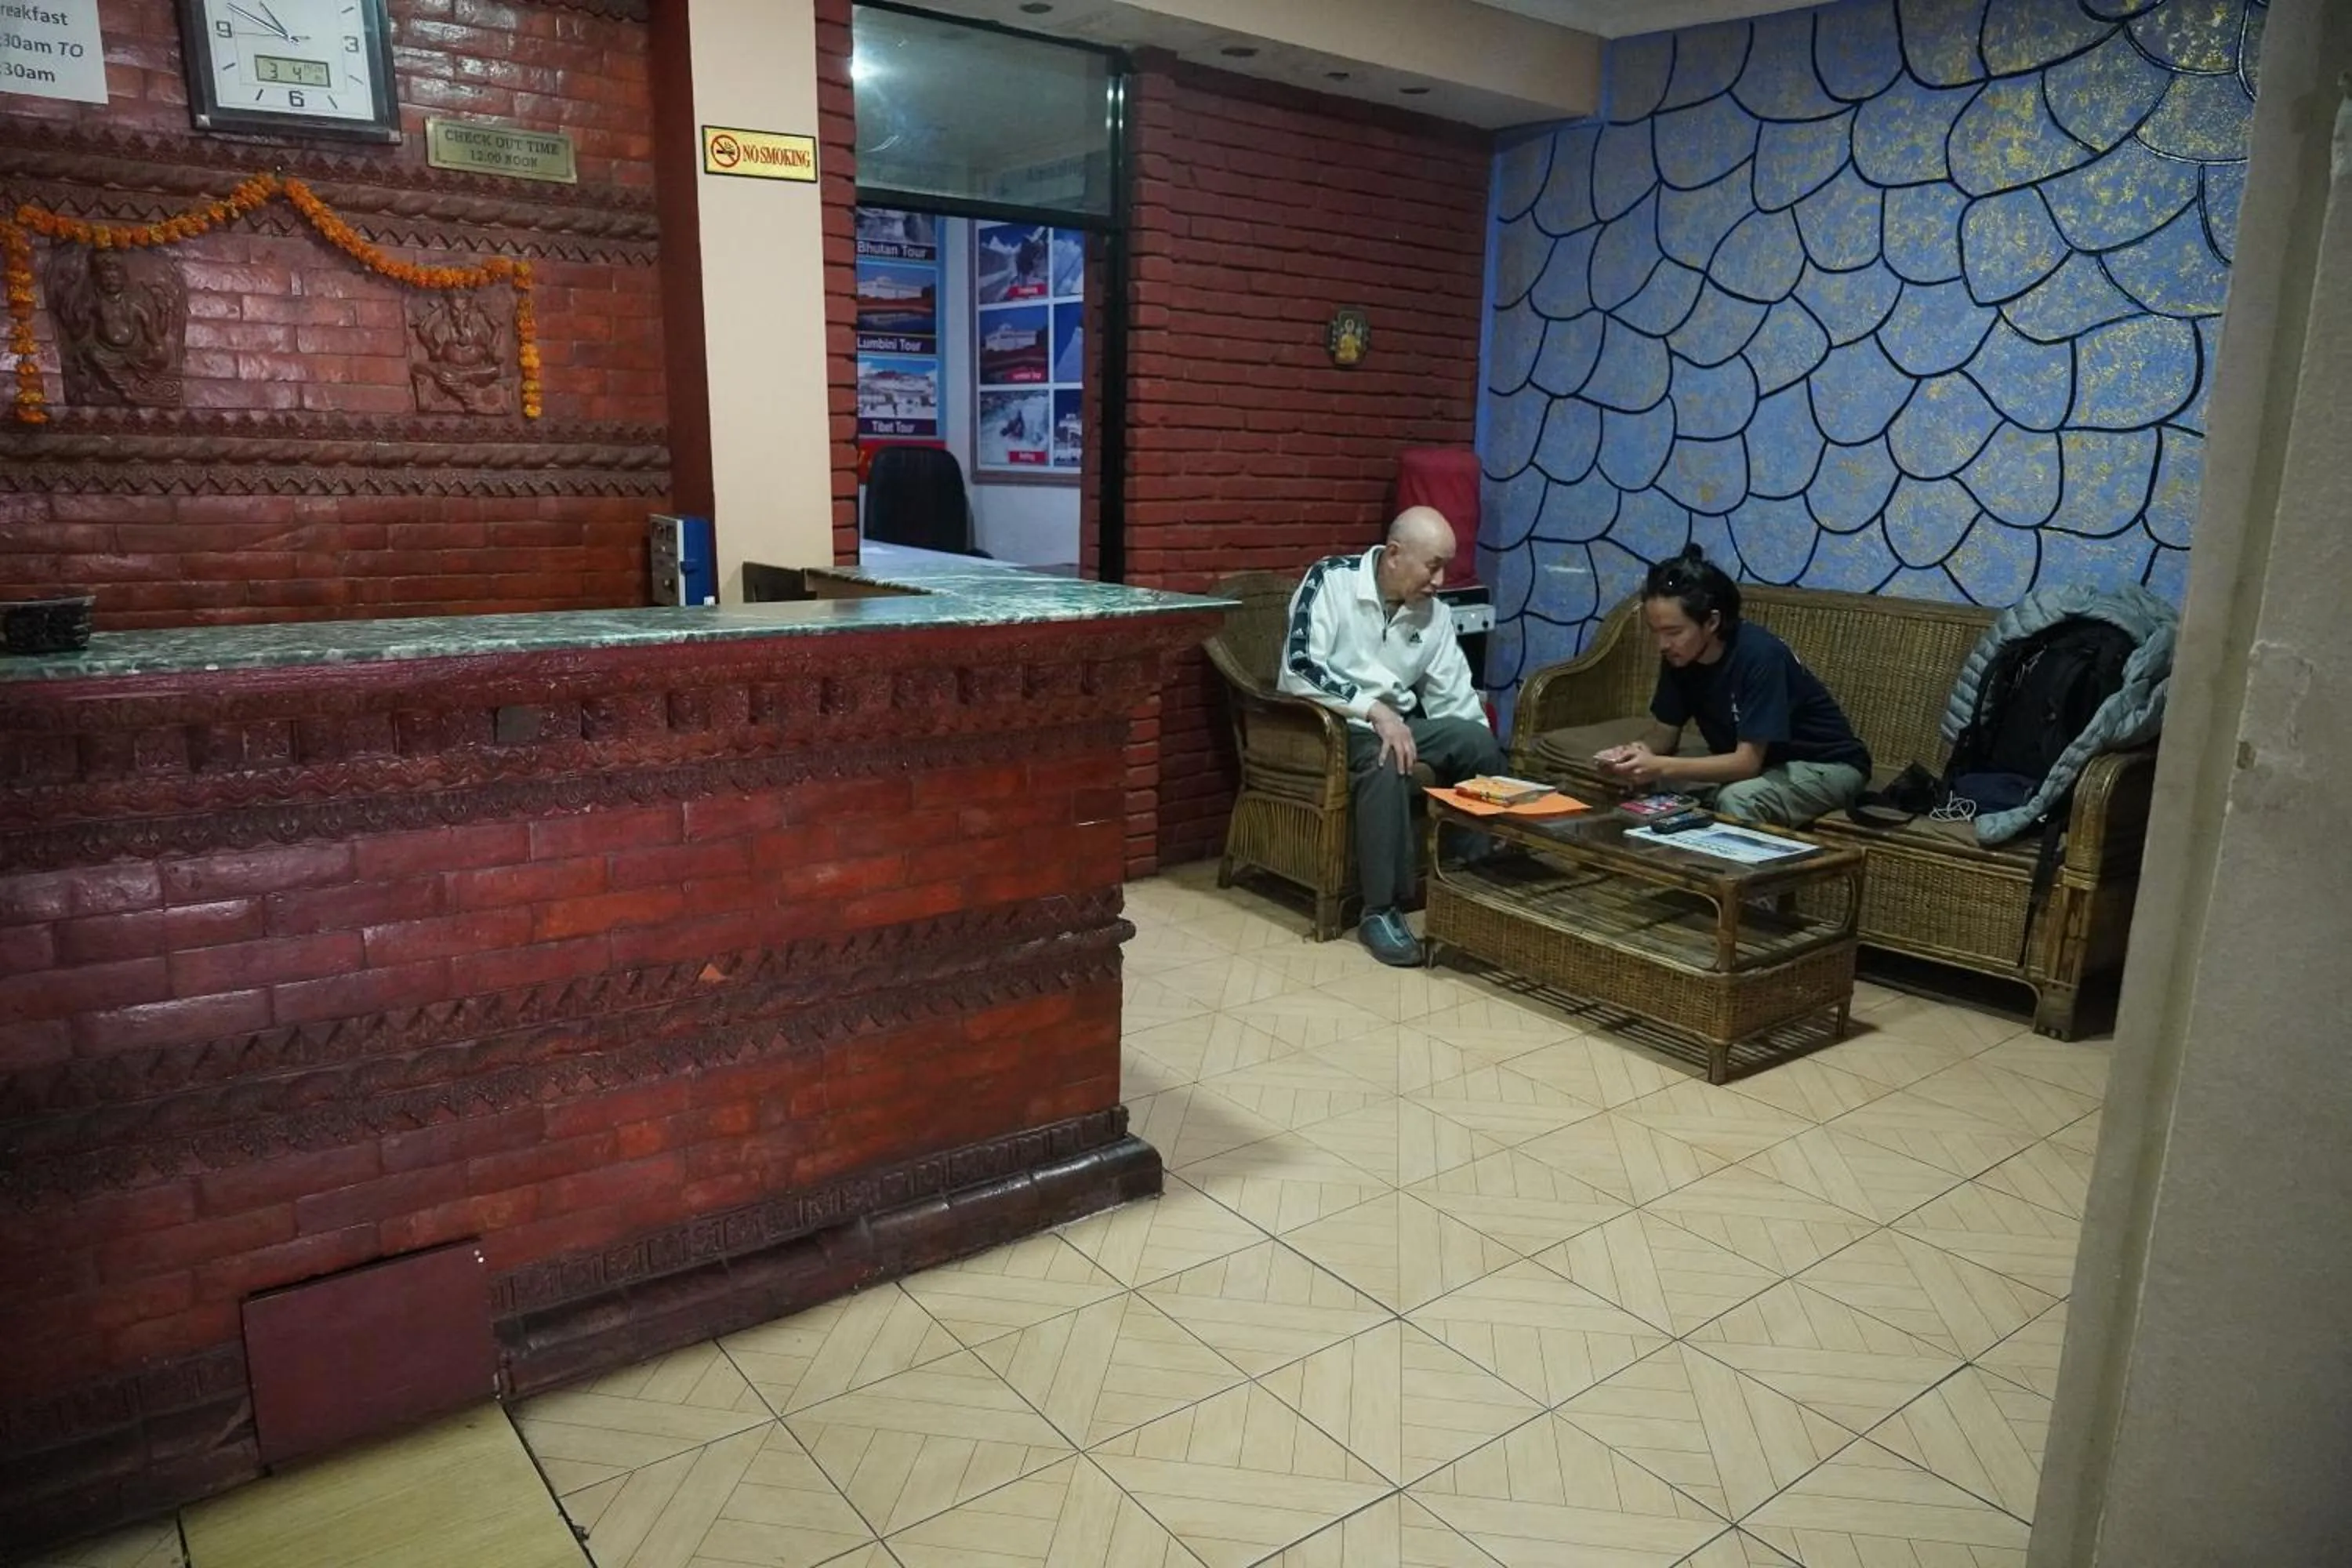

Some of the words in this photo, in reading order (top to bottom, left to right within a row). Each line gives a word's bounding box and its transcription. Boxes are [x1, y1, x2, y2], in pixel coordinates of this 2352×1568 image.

[216, 20, 233, 38] 9
[57, 42, 84, 57] TO
[343, 35, 360, 53] 3
[289, 90, 305, 107] 6
[445, 128, 492, 147] CHECK
[495, 136, 522, 151] OUT
[527, 140, 560, 156] TIME
[505, 154, 539, 168] NOON
[742, 144, 760, 164] NO
[760, 146, 811, 168] SMOKING
[857, 241, 898, 258] Bhutan
[902, 244, 927, 259] Tour
[856, 336, 898, 350] Lumbini
[899, 338, 923, 352] Tour
[871, 420, 894, 434] Tibet
[895, 420, 916, 434] Tour
